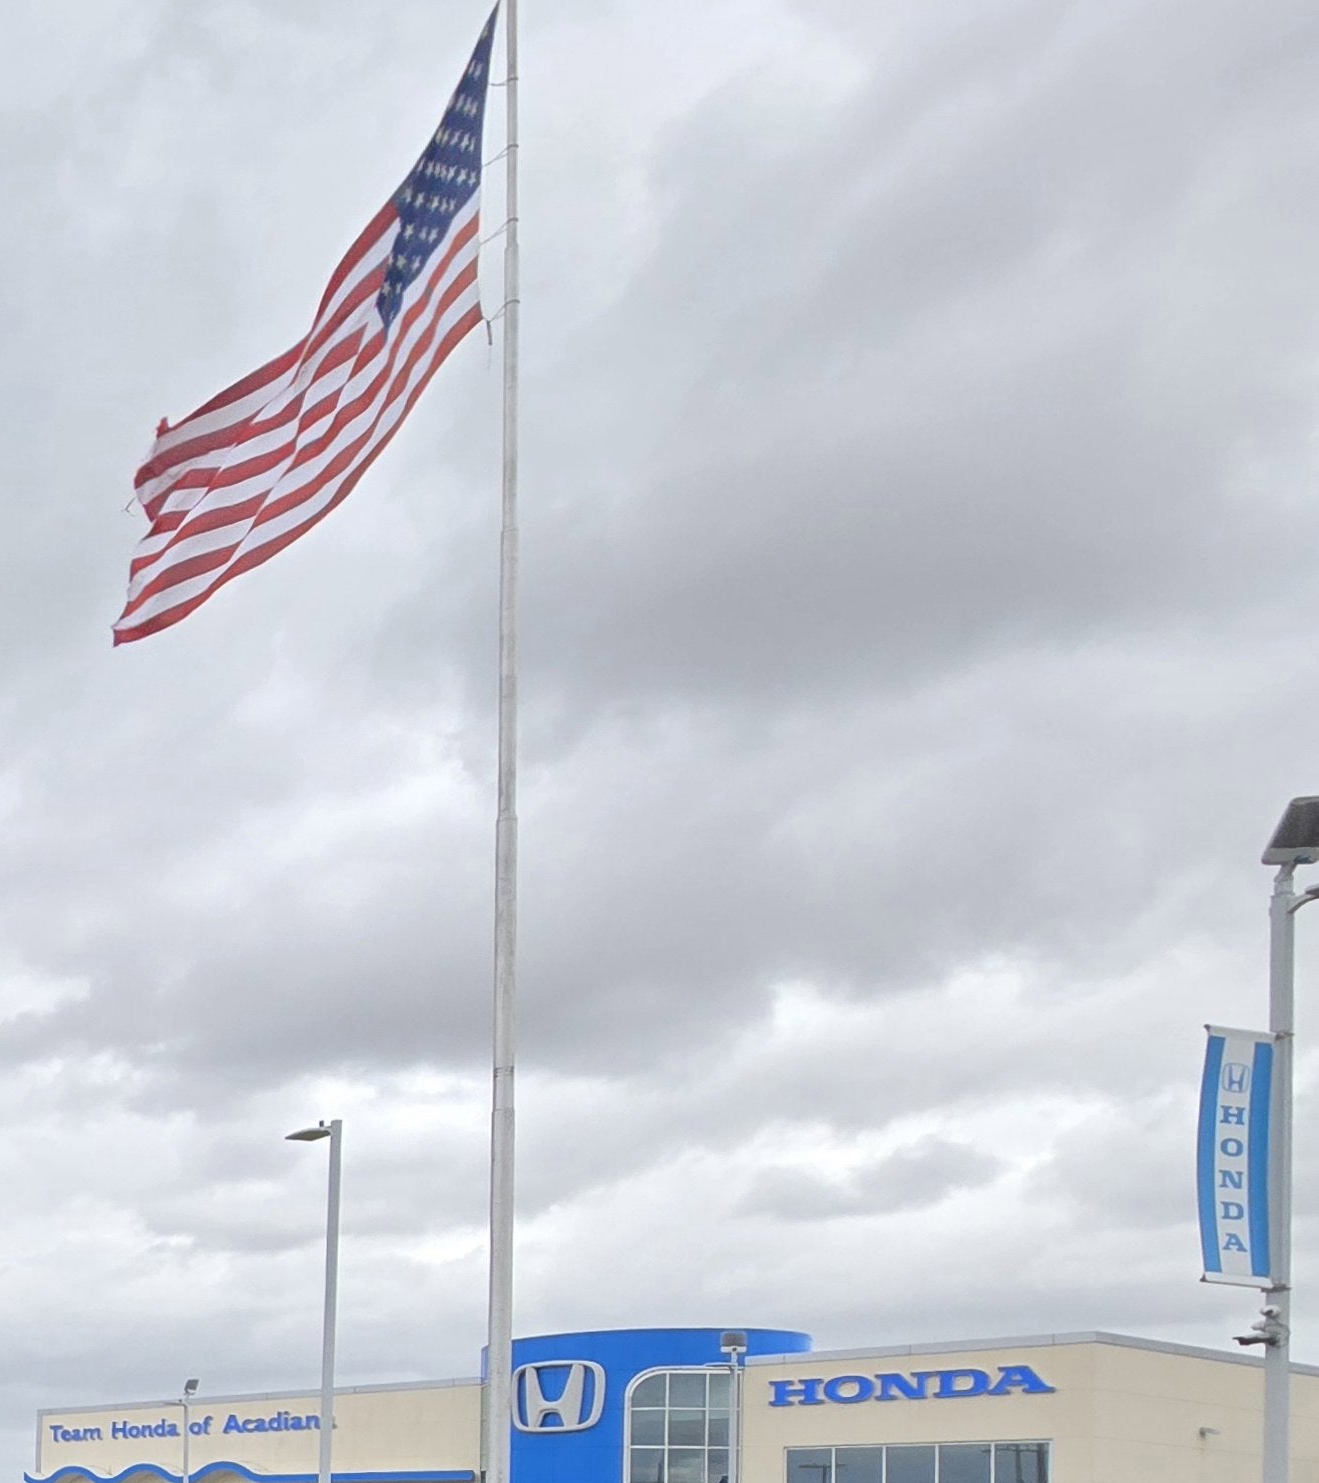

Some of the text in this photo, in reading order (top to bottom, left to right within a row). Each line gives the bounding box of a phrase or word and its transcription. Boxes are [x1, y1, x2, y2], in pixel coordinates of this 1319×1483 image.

[1218, 1105, 1248, 1253] HONDA
[768, 1365, 1056, 1407] HONDA
[49, 1424, 103, 1442] Team
[111, 1418, 180, 1440] Honda
[188, 1416, 213, 1435] of
